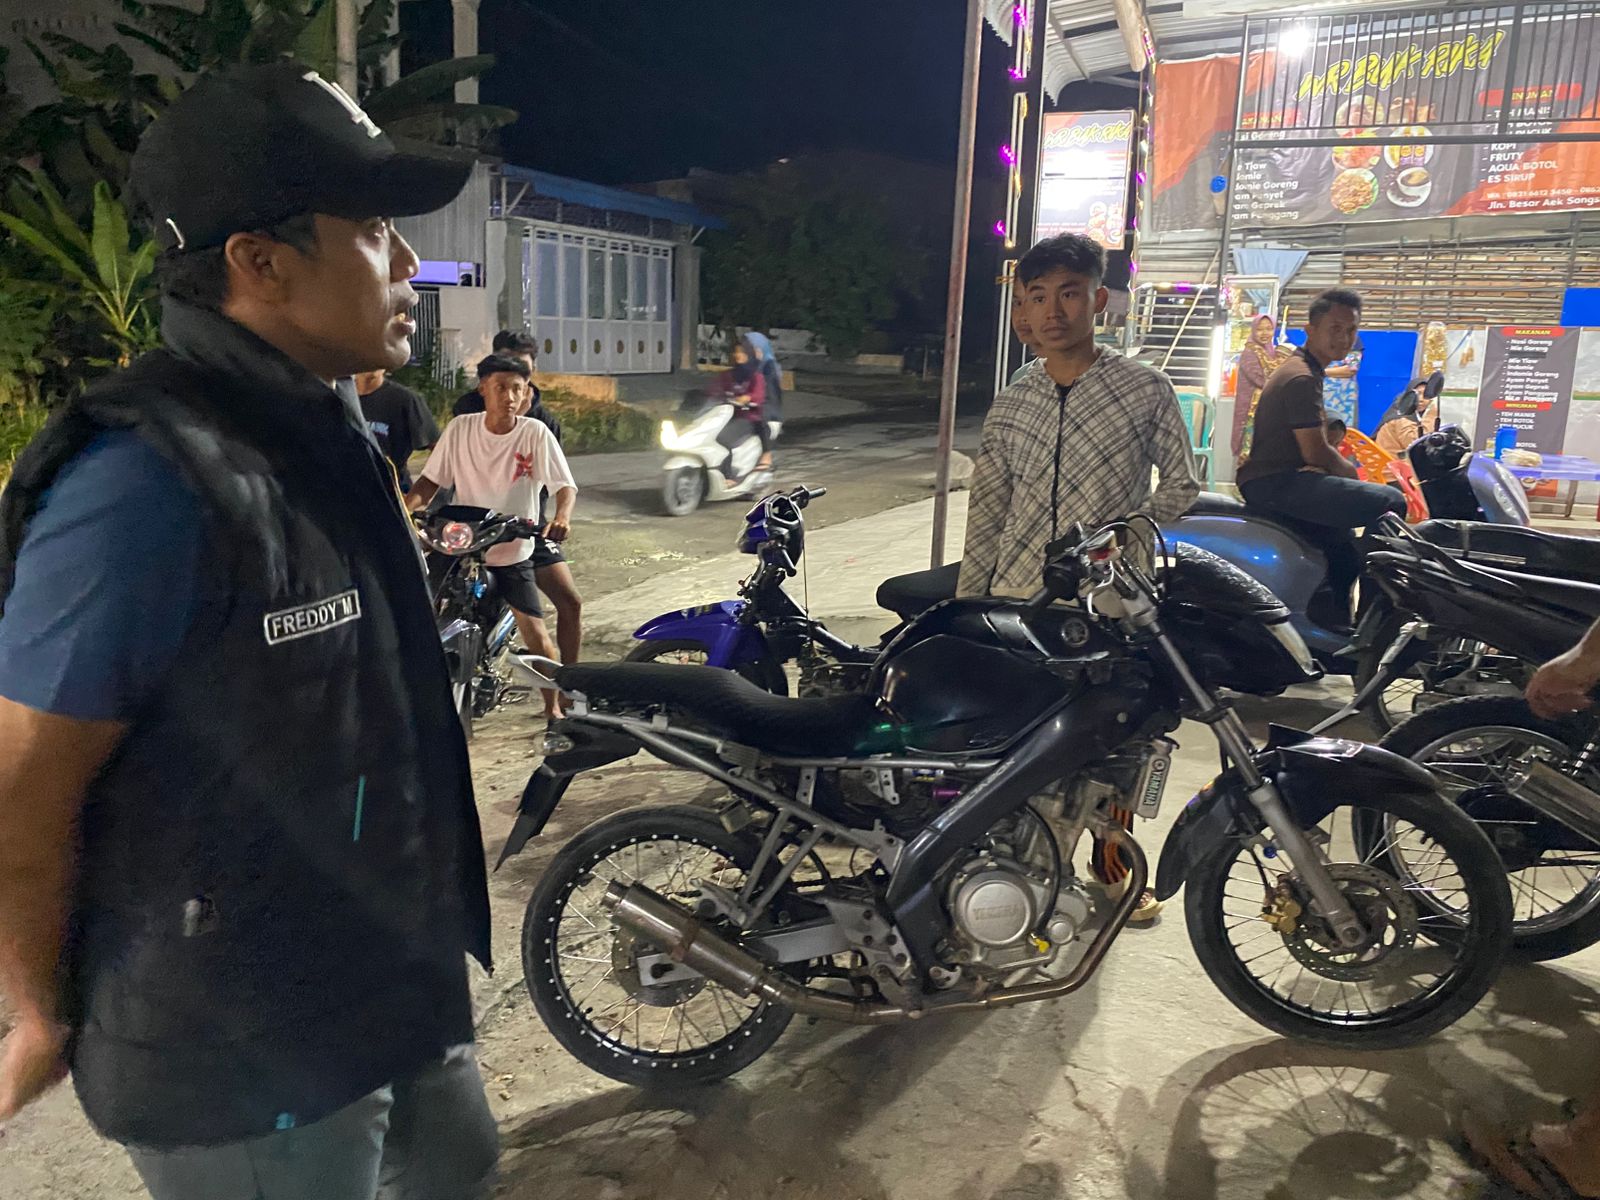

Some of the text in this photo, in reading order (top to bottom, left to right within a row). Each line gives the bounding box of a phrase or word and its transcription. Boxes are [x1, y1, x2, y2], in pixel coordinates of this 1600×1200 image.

[1494, 108, 1515, 118] TH
[1491, 142, 1517, 151] KOPI
[1490, 152, 1524, 161] FRUTY
[1488, 160, 1558, 173] AQUA BOTOL
[1487, 172, 1536, 183] ES SIRUP
[1263, 181, 1299, 190] Goreng
[1488, 201, 1506, 209] Jln.
[1509, 200, 1540, 208] Besar
[1542, 197, 1563, 206] Aek
[1523, 345, 1549, 353] Goreng
[1534, 371, 1559, 379] Goreng
[272, 596, 352, 637] FREDDY M
[1144, 771, 1163, 806] YAMAHA
